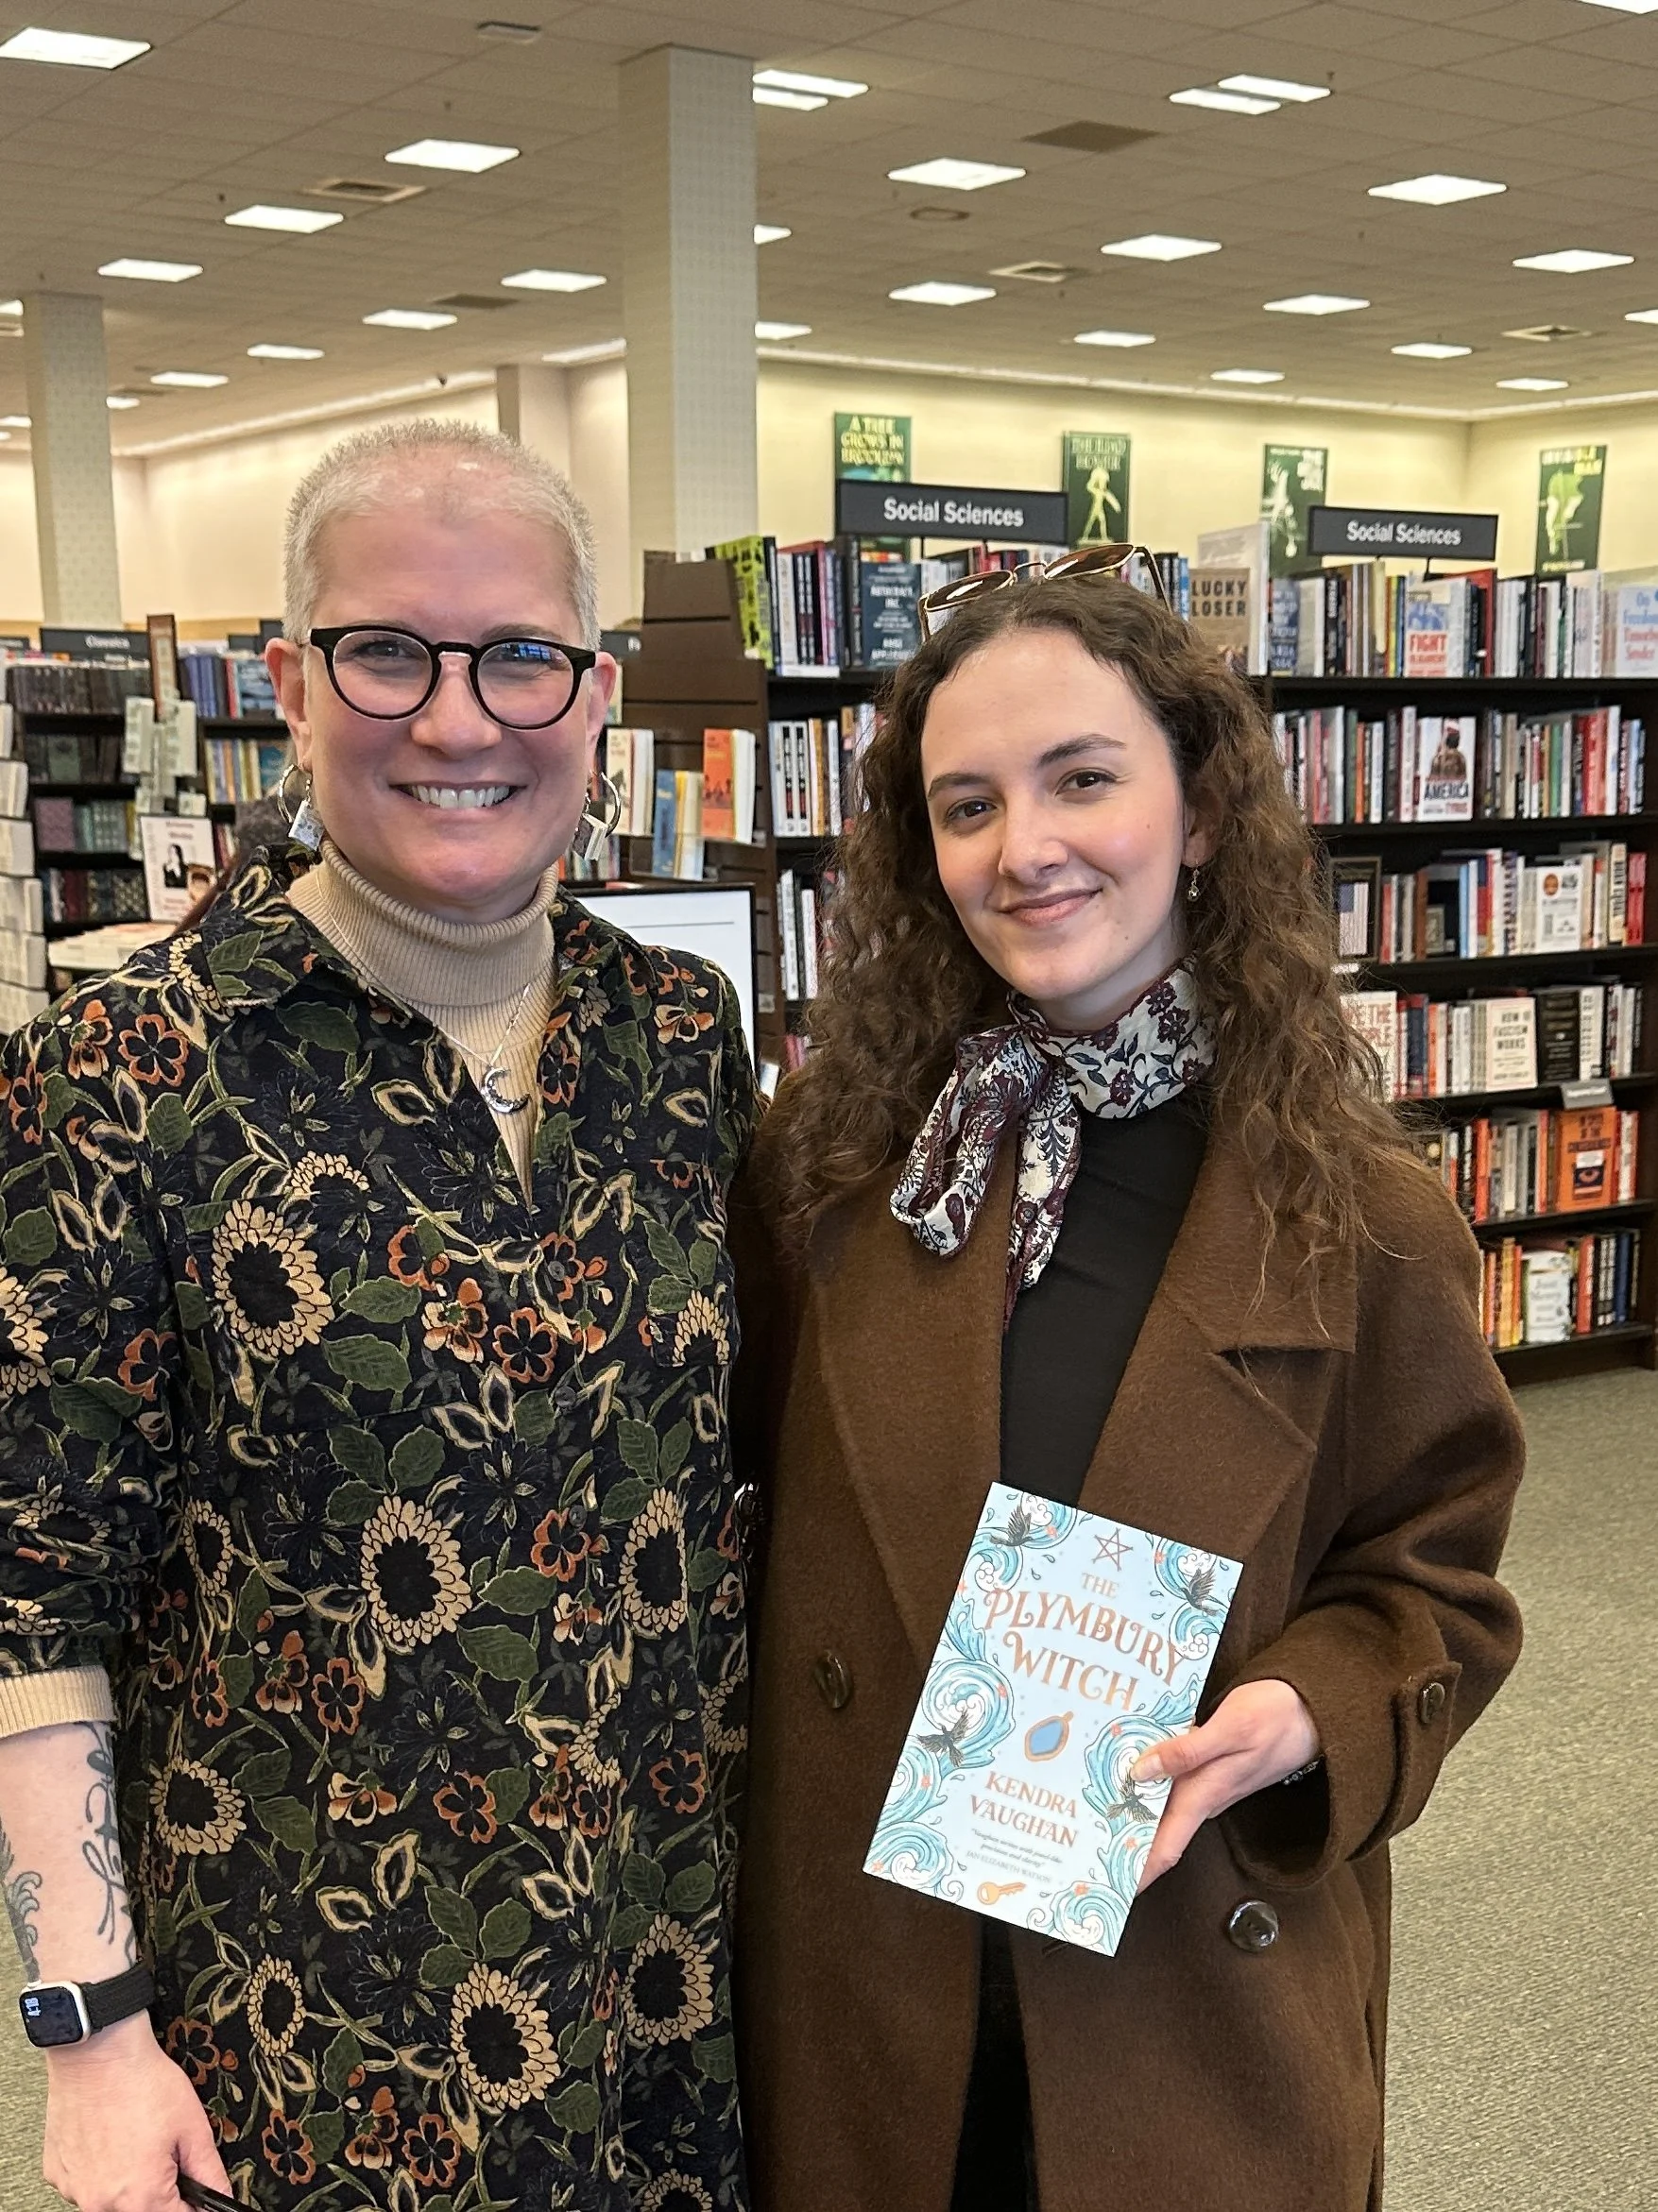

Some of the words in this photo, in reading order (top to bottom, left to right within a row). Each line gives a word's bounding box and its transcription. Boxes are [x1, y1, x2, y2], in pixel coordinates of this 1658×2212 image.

[883, 496, 940, 522] Social
[944, 500, 1024, 528] Sciences
[1346, 520, 1393, 543] Social
[1396, 522, 1461, 546] Sciences
[1191, 579, 1247, 597] LUCKY
[1191, 600, 1246, 618] LOSER
[1424, 783, 1469, 801] AMERICA
[1081, 1573, 1120, 1599] THE
[983, 1588, 1186, 1687] PLYMBURY
[1002, 1630, 1139, 1711] WITCH
[985, 1770, 1077, 1819] KENDRA
[970, 1794, 1079, 1848] VAUGHAN
[981, 1854, 1020, 1874] ELIZABETH
